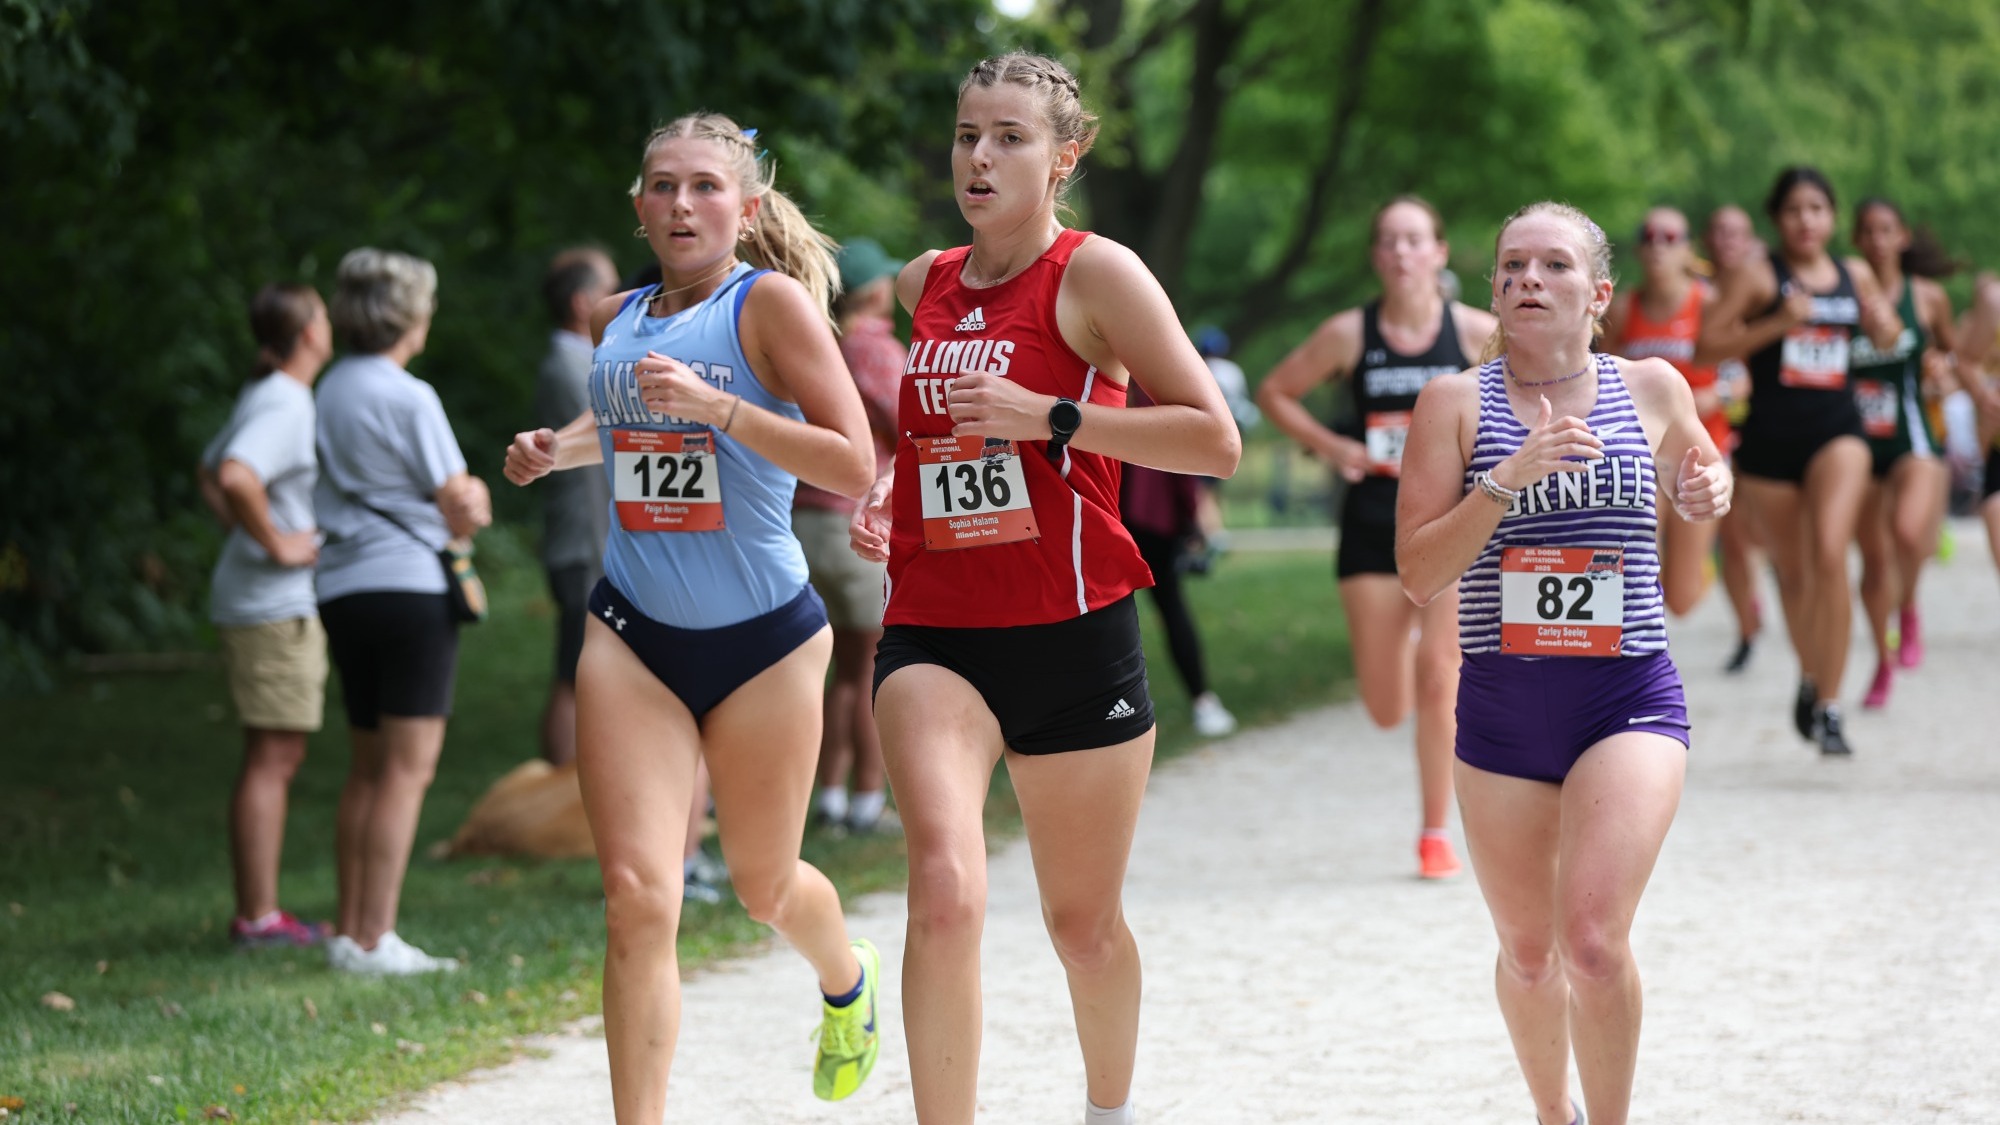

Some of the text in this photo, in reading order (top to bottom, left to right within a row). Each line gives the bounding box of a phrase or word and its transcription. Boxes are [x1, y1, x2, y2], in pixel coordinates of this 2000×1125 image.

[955, 321, 986, 331] adidas
[902, 340, 1015, 376] ILLINOIS
[930, 445, 962, 454] INVITATIONAL
[634, 455, 704, 498] 122
[936, 464, 1011, 512] 136
[645, 503, 662, 514] Paige
[948, 516, 999, 530] Sophia Halama
[955, 528, 998, 539] Illinois Tech
[1521, 556, 1565, 564] INVITATIONAL
[1536, 576, 1594, 620] 82
[1538, 626, 1588, 639] Carley Seeley
[1563, 639, 1592, 648] College
